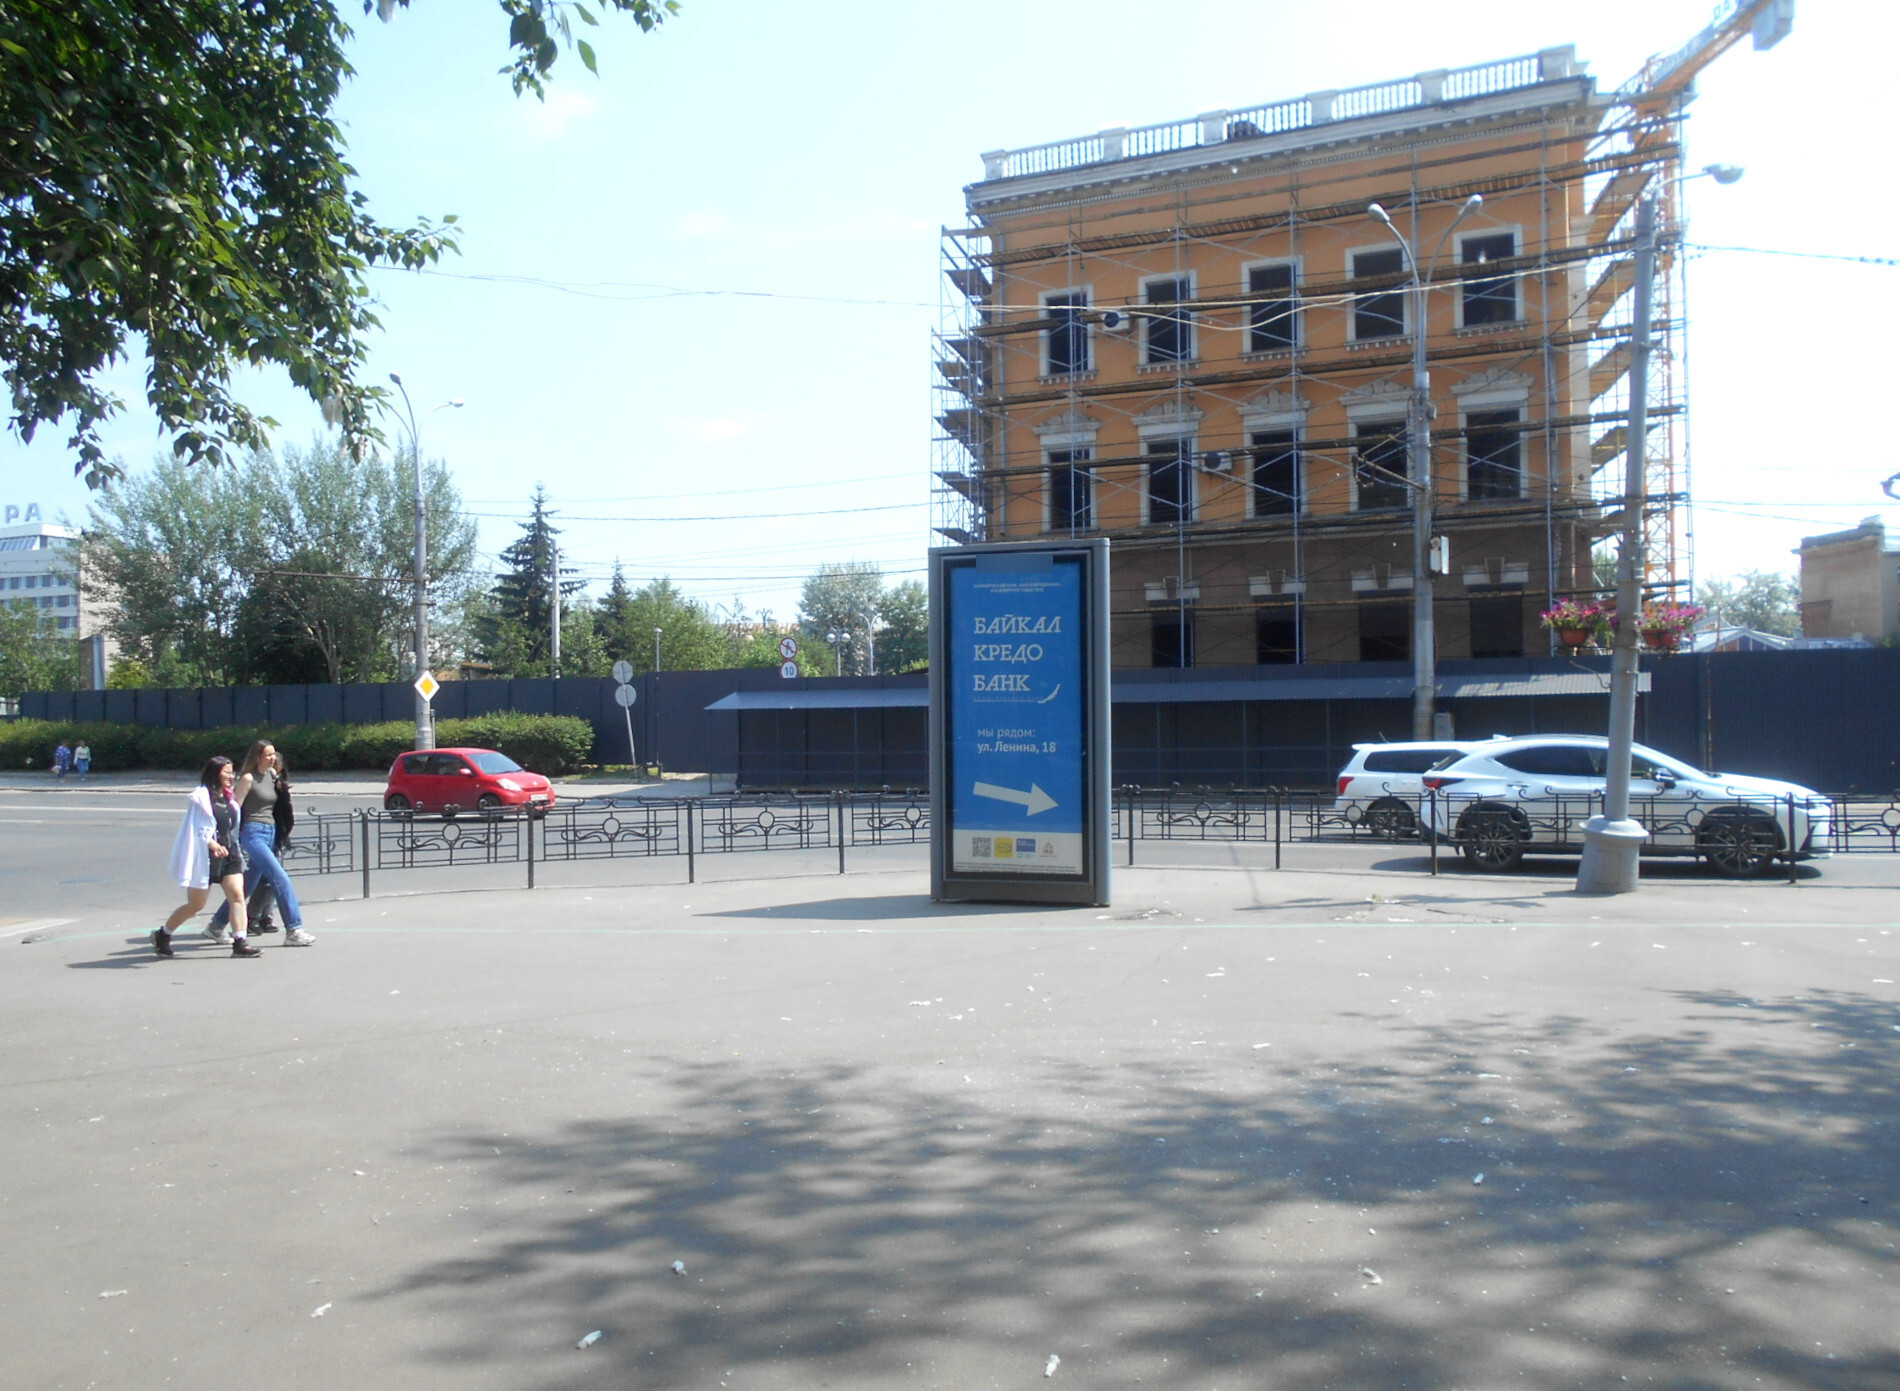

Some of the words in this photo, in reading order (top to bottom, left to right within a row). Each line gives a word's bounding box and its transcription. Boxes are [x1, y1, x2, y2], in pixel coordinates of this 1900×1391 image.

[973, 613, 1062, 634] БАЙКАЛ
[973, 643, 1044, 664] КРЕДО
[785, 666, 795, 676] 10
[972, 674, 1031, 692] БАНК
[977, 729, 994, 738] мы
[997, 729, 1036, 740] рядом:
[977, 743, 993, 754] ул.
[994, 741, 1040, 754] Ленина,
[1042, 741, 1057, 753] 18
